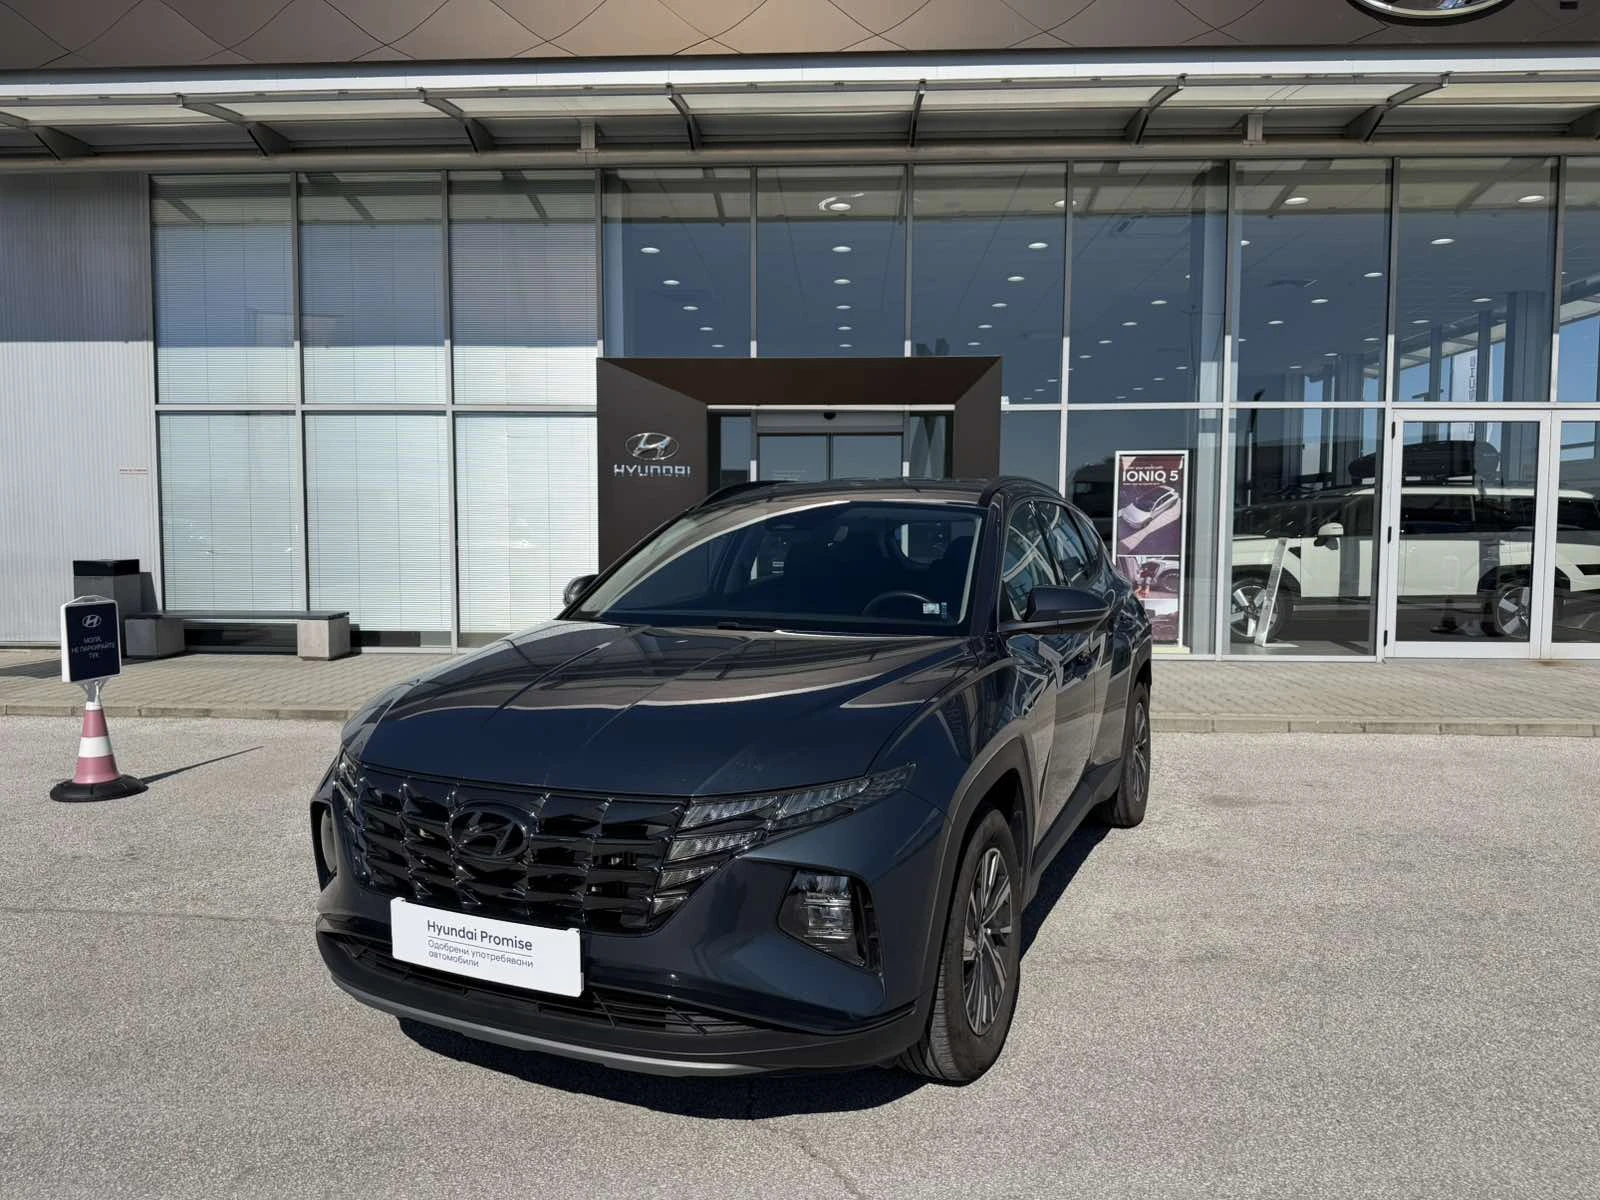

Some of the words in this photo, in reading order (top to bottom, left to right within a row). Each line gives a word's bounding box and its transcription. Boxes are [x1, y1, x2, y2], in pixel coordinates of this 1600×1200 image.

[613, 464, 691, 477] HYUNDAI
[1122, 470, 1166, 483] IONIQ
[1169, 470, 1179, 481] 5
[427, 920, 478, 940] Hyundai
[480, 930, 533, 951] Promise
[427, 939, 470, 955] Одобрени
[471, 950, 535, 968] употребявани
[428, 950, 480, 968] автомобили
